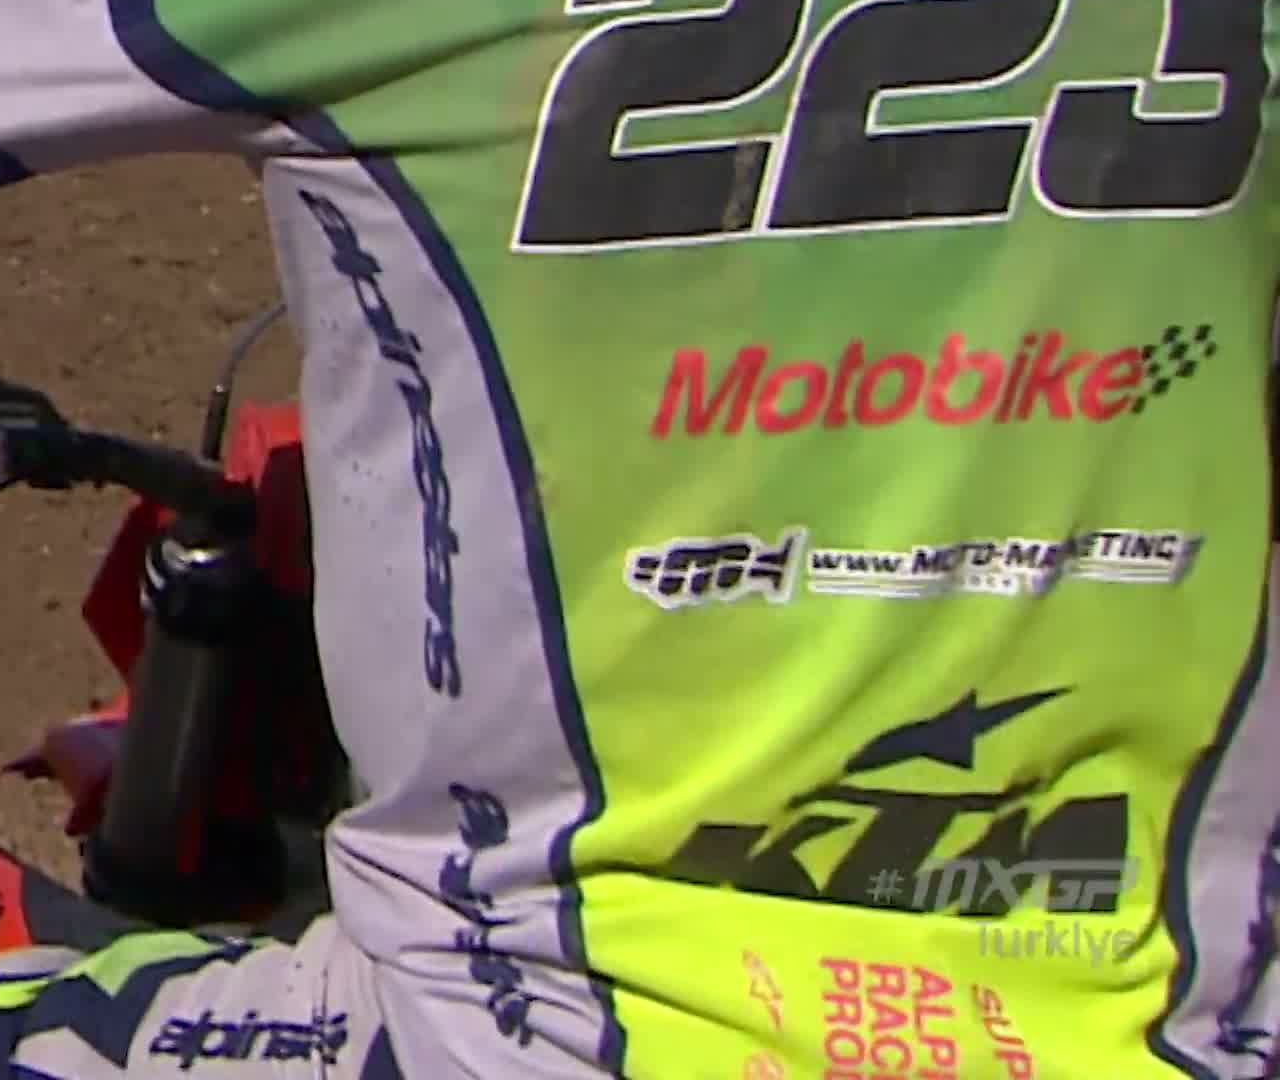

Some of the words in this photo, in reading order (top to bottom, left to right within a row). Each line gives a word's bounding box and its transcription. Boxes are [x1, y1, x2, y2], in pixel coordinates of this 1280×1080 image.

[651, 330, 1144, 441] Motobike
[662, 783, 1129, 918] KTM
[819, 956, 867, 1080] PRO
